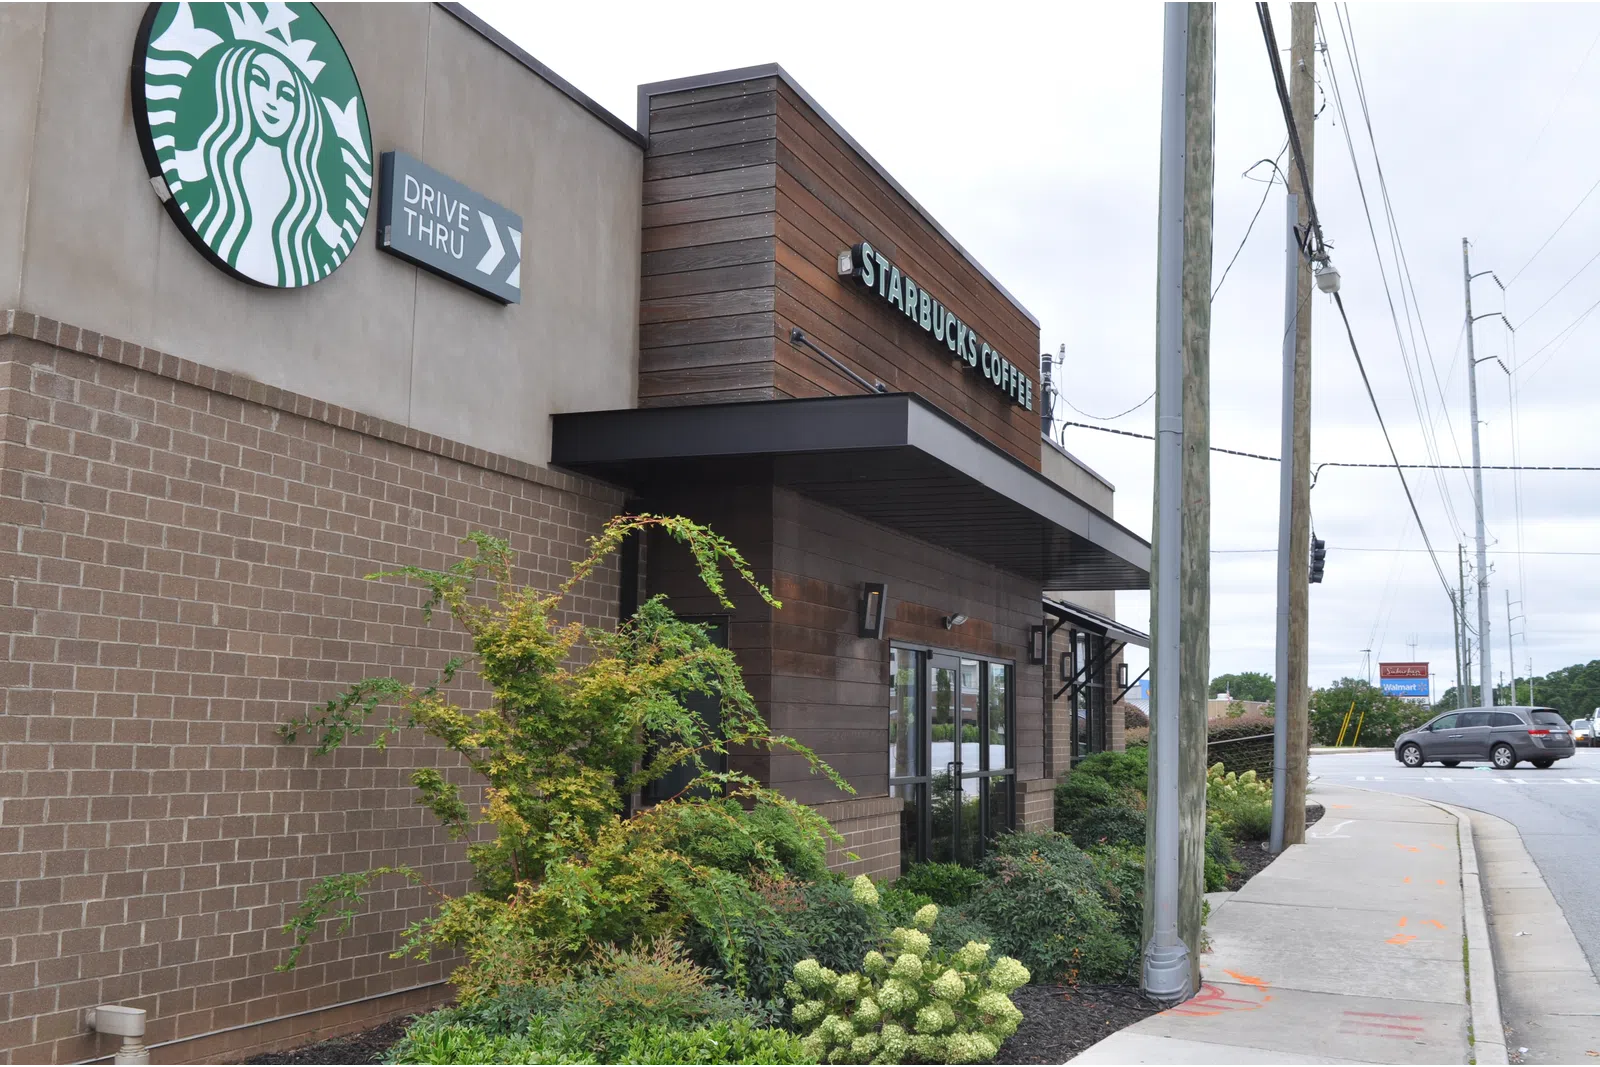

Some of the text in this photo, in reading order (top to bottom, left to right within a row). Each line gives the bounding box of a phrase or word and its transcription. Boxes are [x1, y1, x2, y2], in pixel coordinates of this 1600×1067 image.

[404, 174, 470, 232] DRIVE
[403, 206, 464, 259] THRU
[859, 242, 1033, 411] STARBUCKS COFFEE
